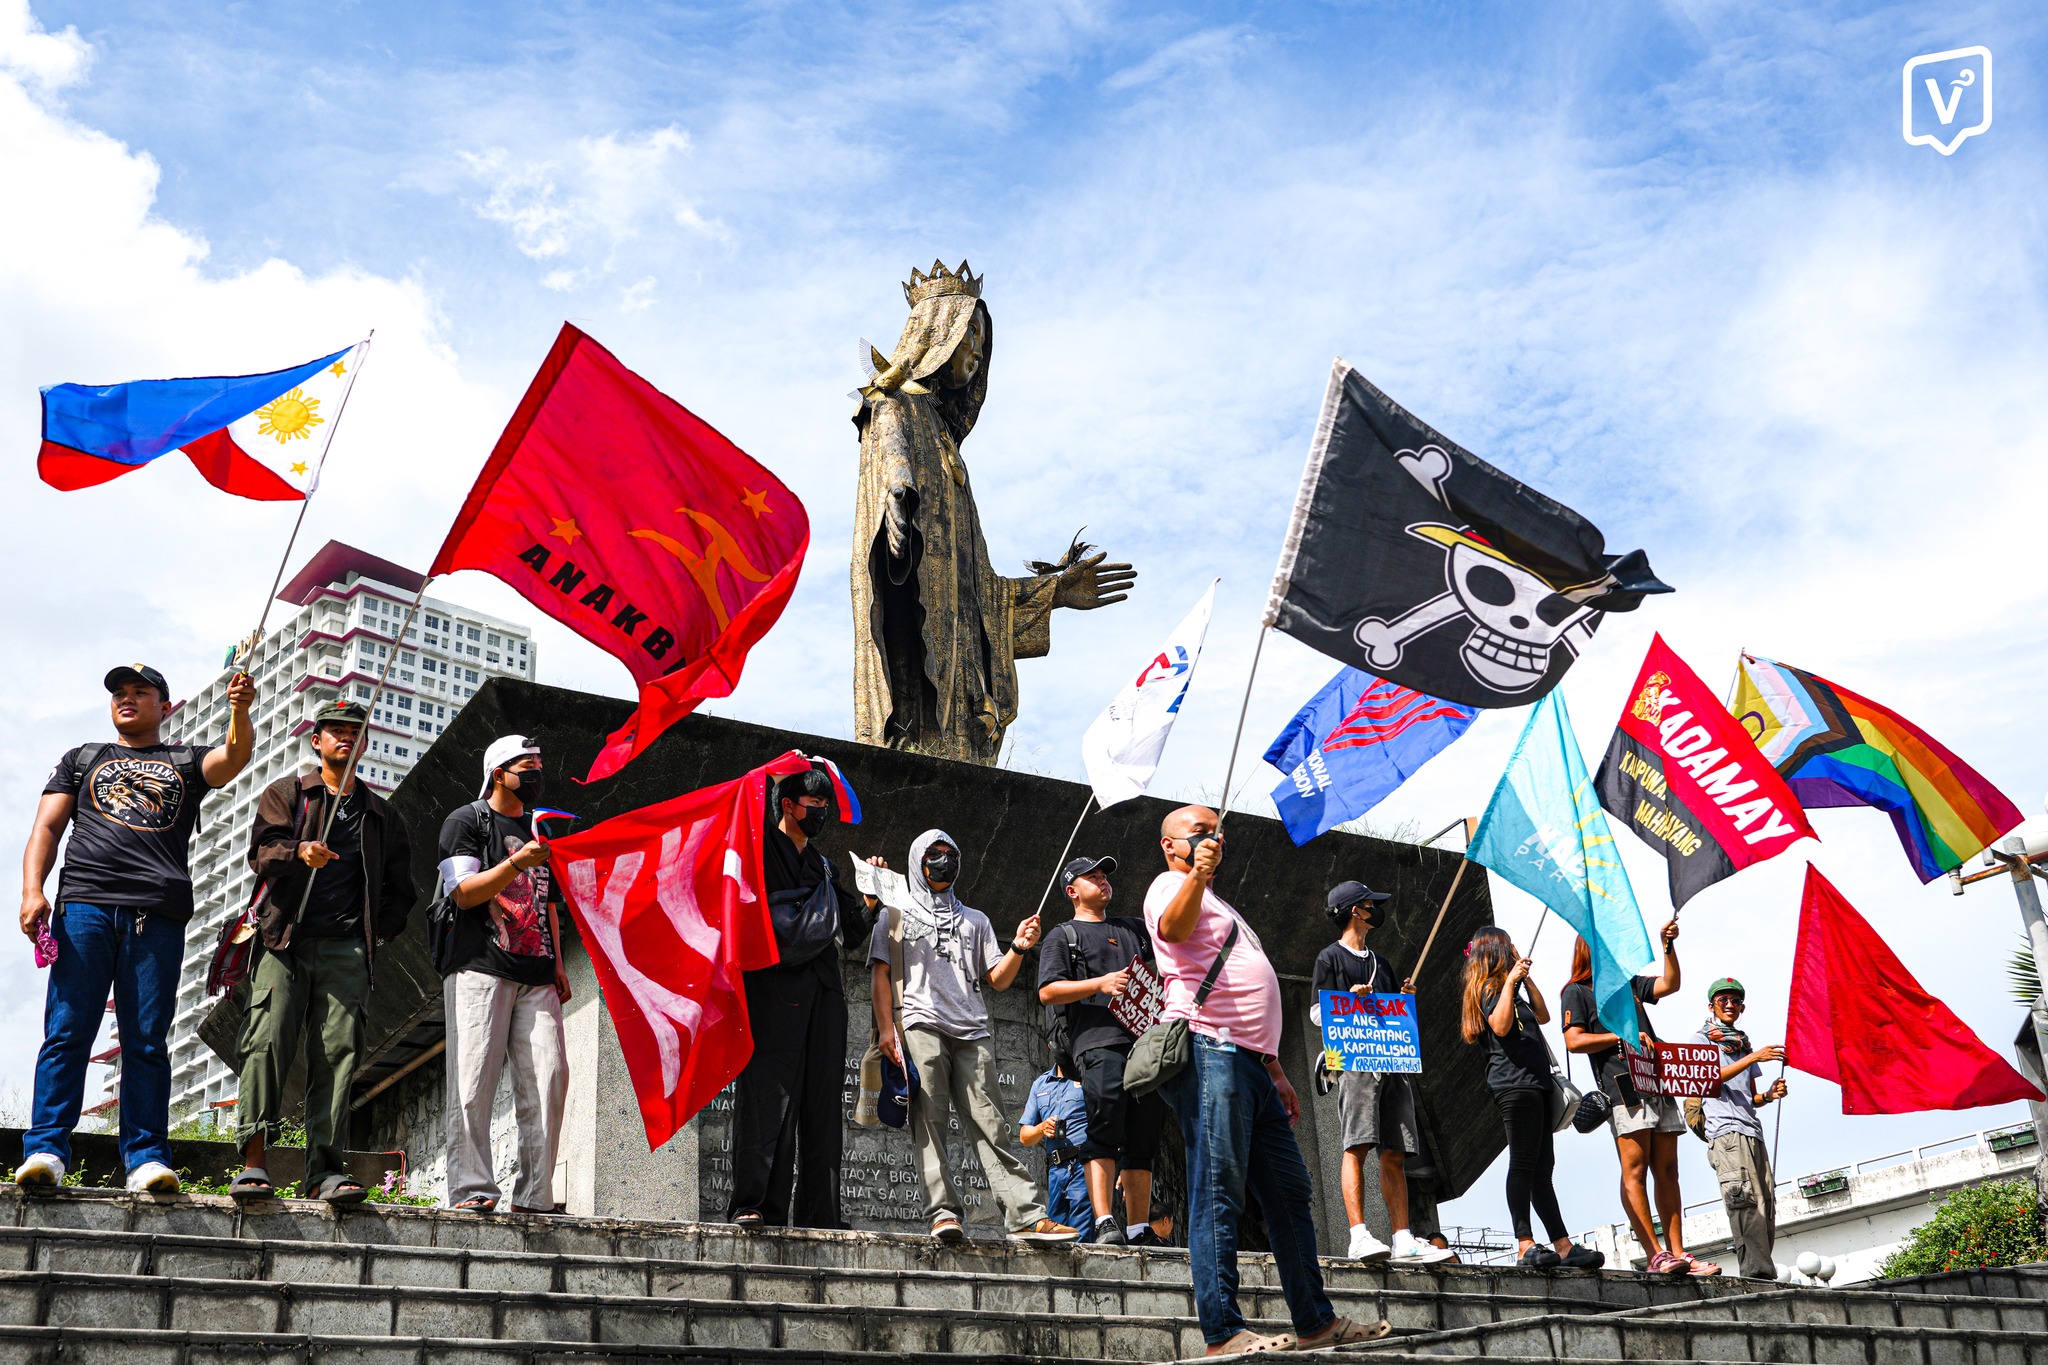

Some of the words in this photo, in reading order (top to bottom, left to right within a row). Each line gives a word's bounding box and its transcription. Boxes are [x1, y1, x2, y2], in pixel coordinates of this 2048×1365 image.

[1659, 688, 1795, 845] KADAMAY
[97, 786, 108, 795] 20
[1126, 974, 1140, 999] NG
[1330, 995, 1408, 1017] IBAGSAK
[1353, 1014, 1378, 1028] ANG
[1328, 1026, 1411, 1043] BURUKRATANG
[1343, 1041, 1416, 1056] KAPITALISMO
[1662, 1050, 1673, 1060] sa
[1678, 1048, 1718, 1062] FLOOD
[1664, 1063, 1720, 1079] PROJECTS
[842, 1150, 896, 1166] YAGANG
[878, 1188, 898, 1200] SA
[863, 1204, 925, 1220] TATANDA
